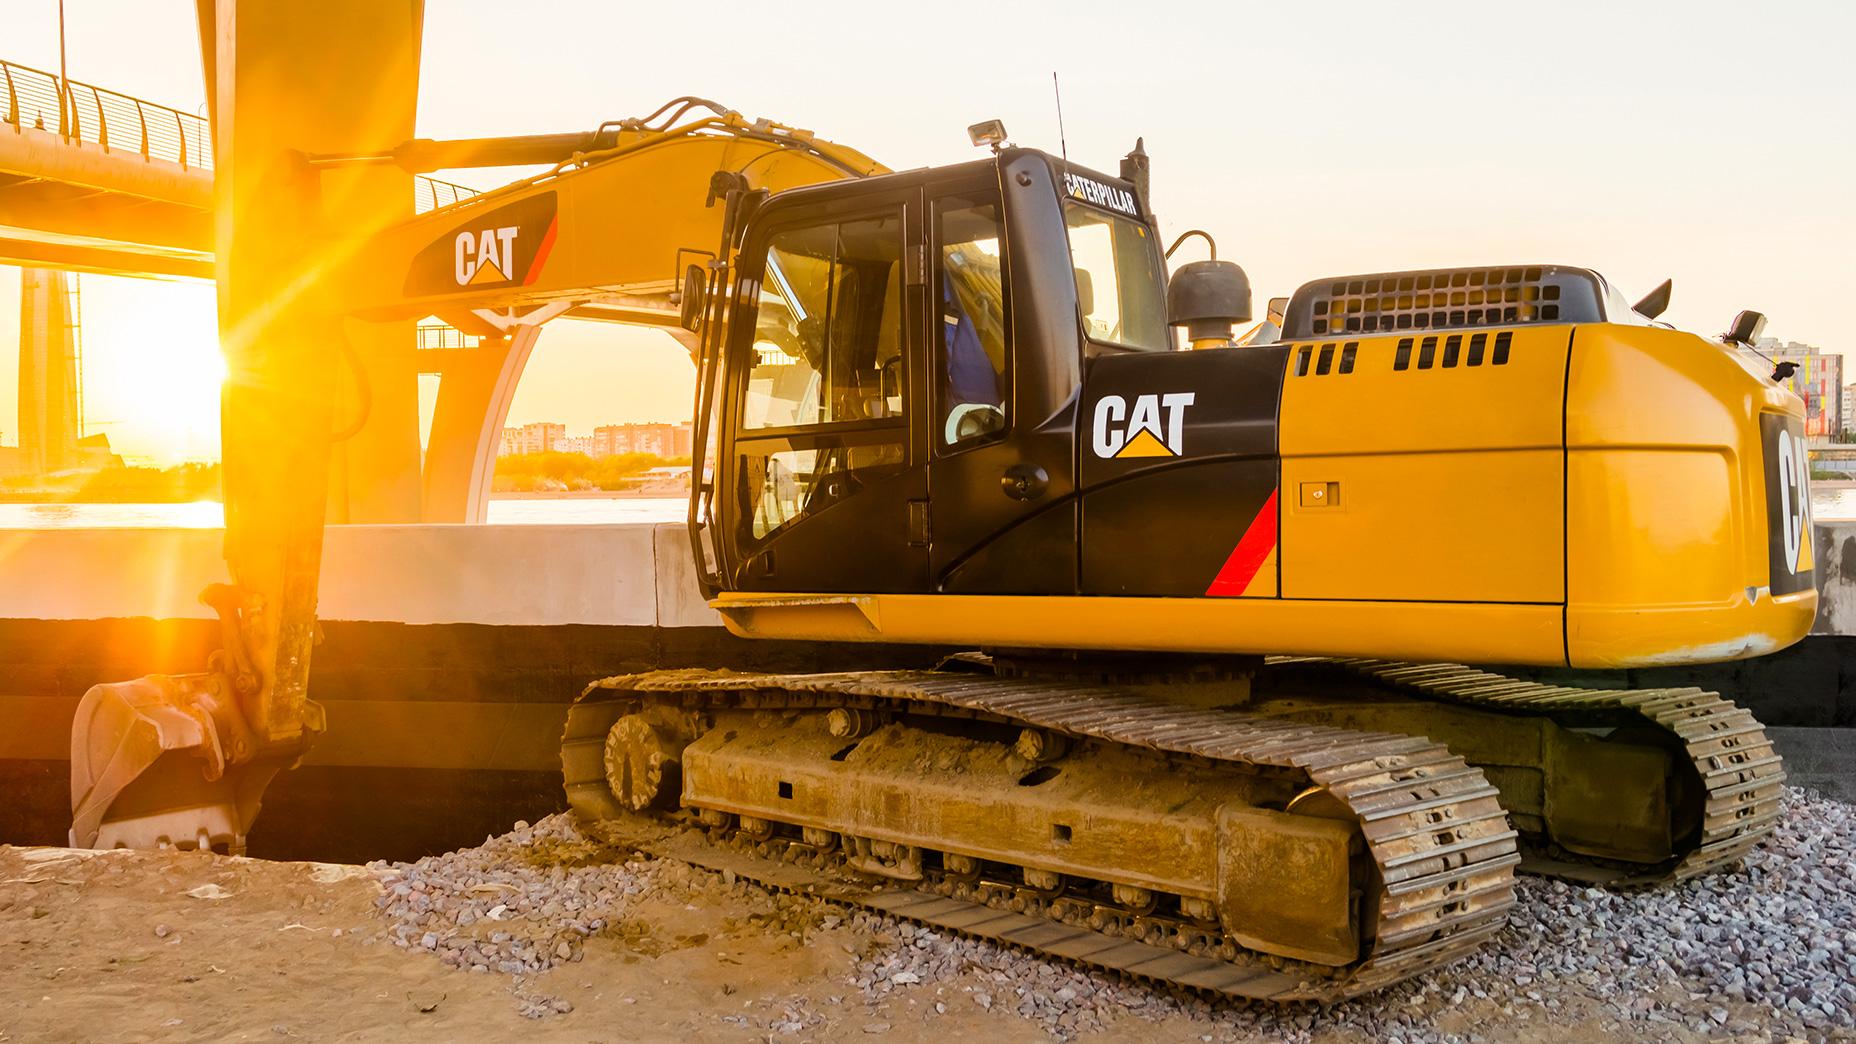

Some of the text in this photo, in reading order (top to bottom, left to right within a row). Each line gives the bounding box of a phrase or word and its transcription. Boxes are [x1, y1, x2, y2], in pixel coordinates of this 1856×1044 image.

[1064, 172, 1137, 215] CATERPILLAR
[455, 226, 518, 286] CAT
[1093, 392, 1195, 458] CAT
